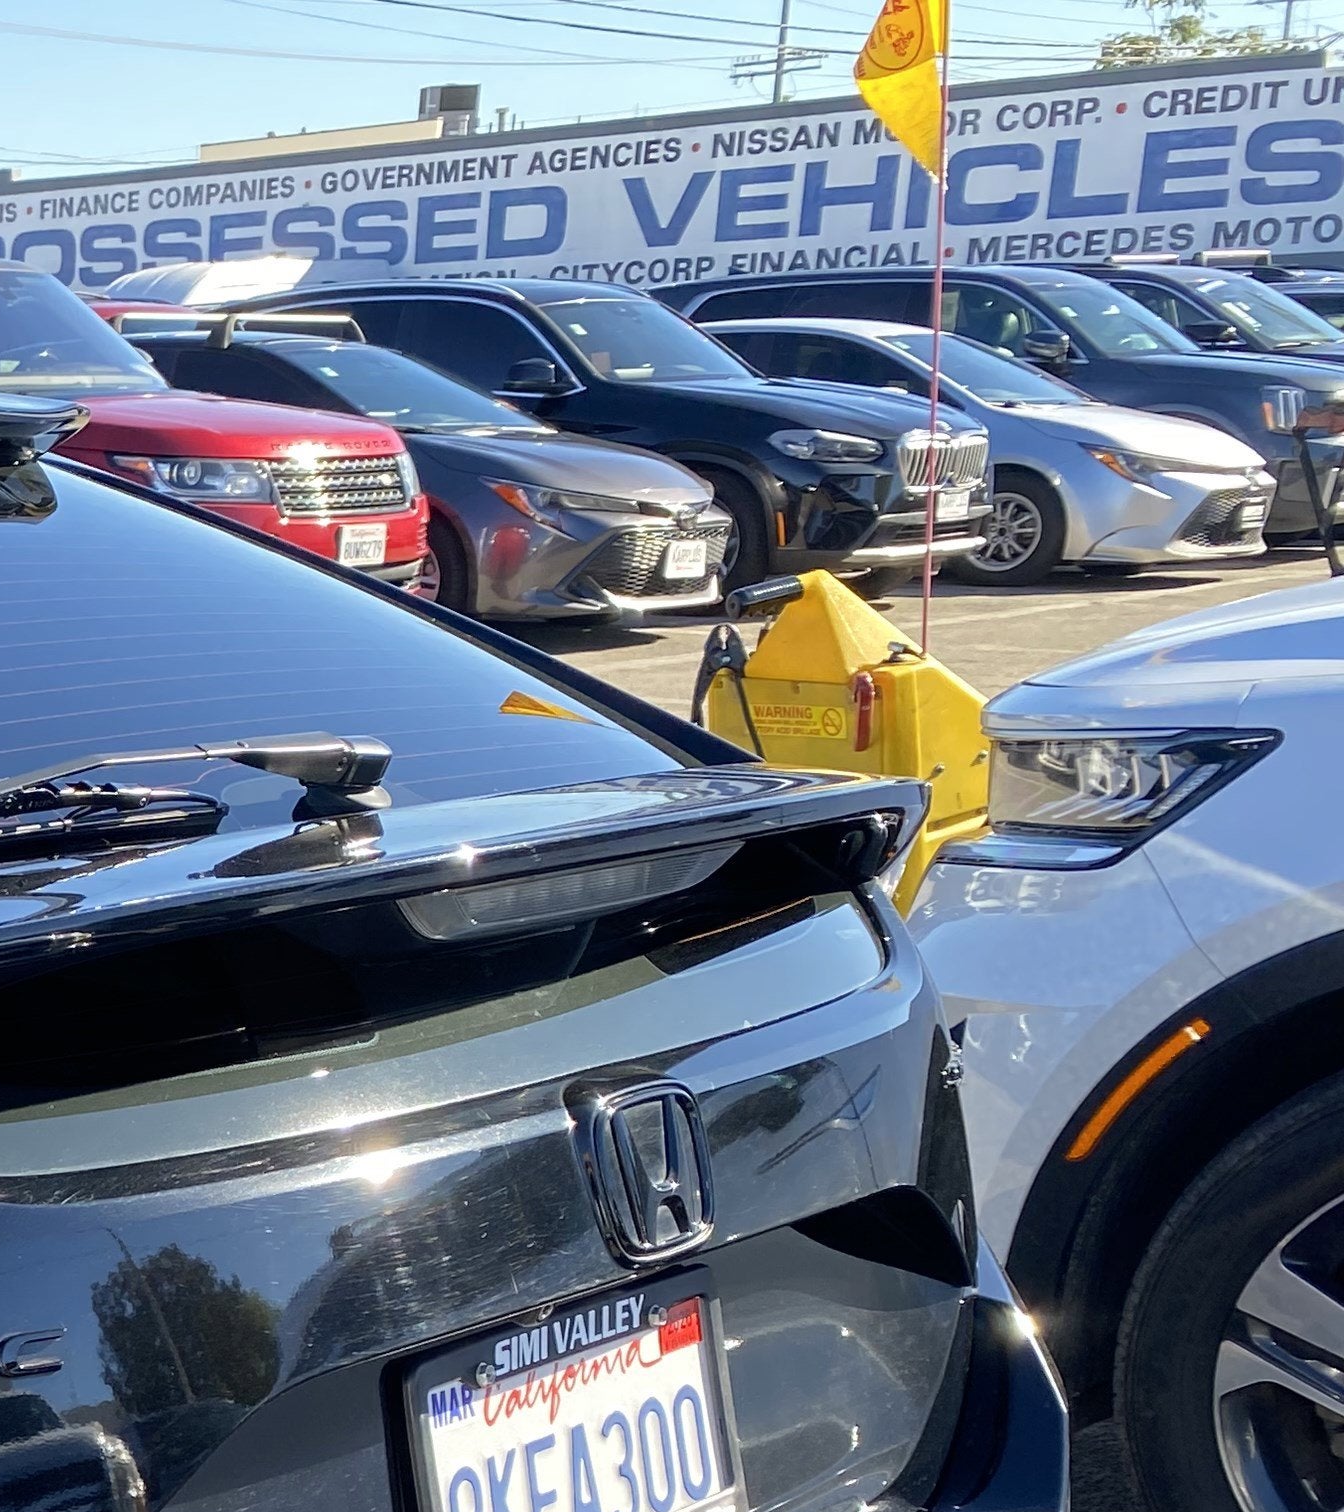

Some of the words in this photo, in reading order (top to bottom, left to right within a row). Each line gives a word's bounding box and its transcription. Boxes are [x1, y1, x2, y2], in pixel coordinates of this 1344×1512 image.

[39, 190, 140, 220] FINANCE
[148, 175, 296, 210] COMPANIES
[320, 154, 519, 194] GOVERNMENT
[527, 137, 683, 176] AGENCIES
[711, 121, 842, 159] NISSAN
[996, 97, 1103, 131] CORP.
[1143, 80, 1290, 119] CREDIT
[622, 119, 1344, 248] VEHICLES
[549, 256, 715, 285] CITYCORP
[728, 241, 930, 276] FINANCIAL
[967, 222, 1195, 264] MERCEDES
[753, 705, 813, 719] WARNING
[494, 1325, 549, 1377] SIMI
[552, 1294, 645, 1355] VALLEY
[431, 1384, 476, 1429] MAR
[483, 1336, 662, 1427] California
